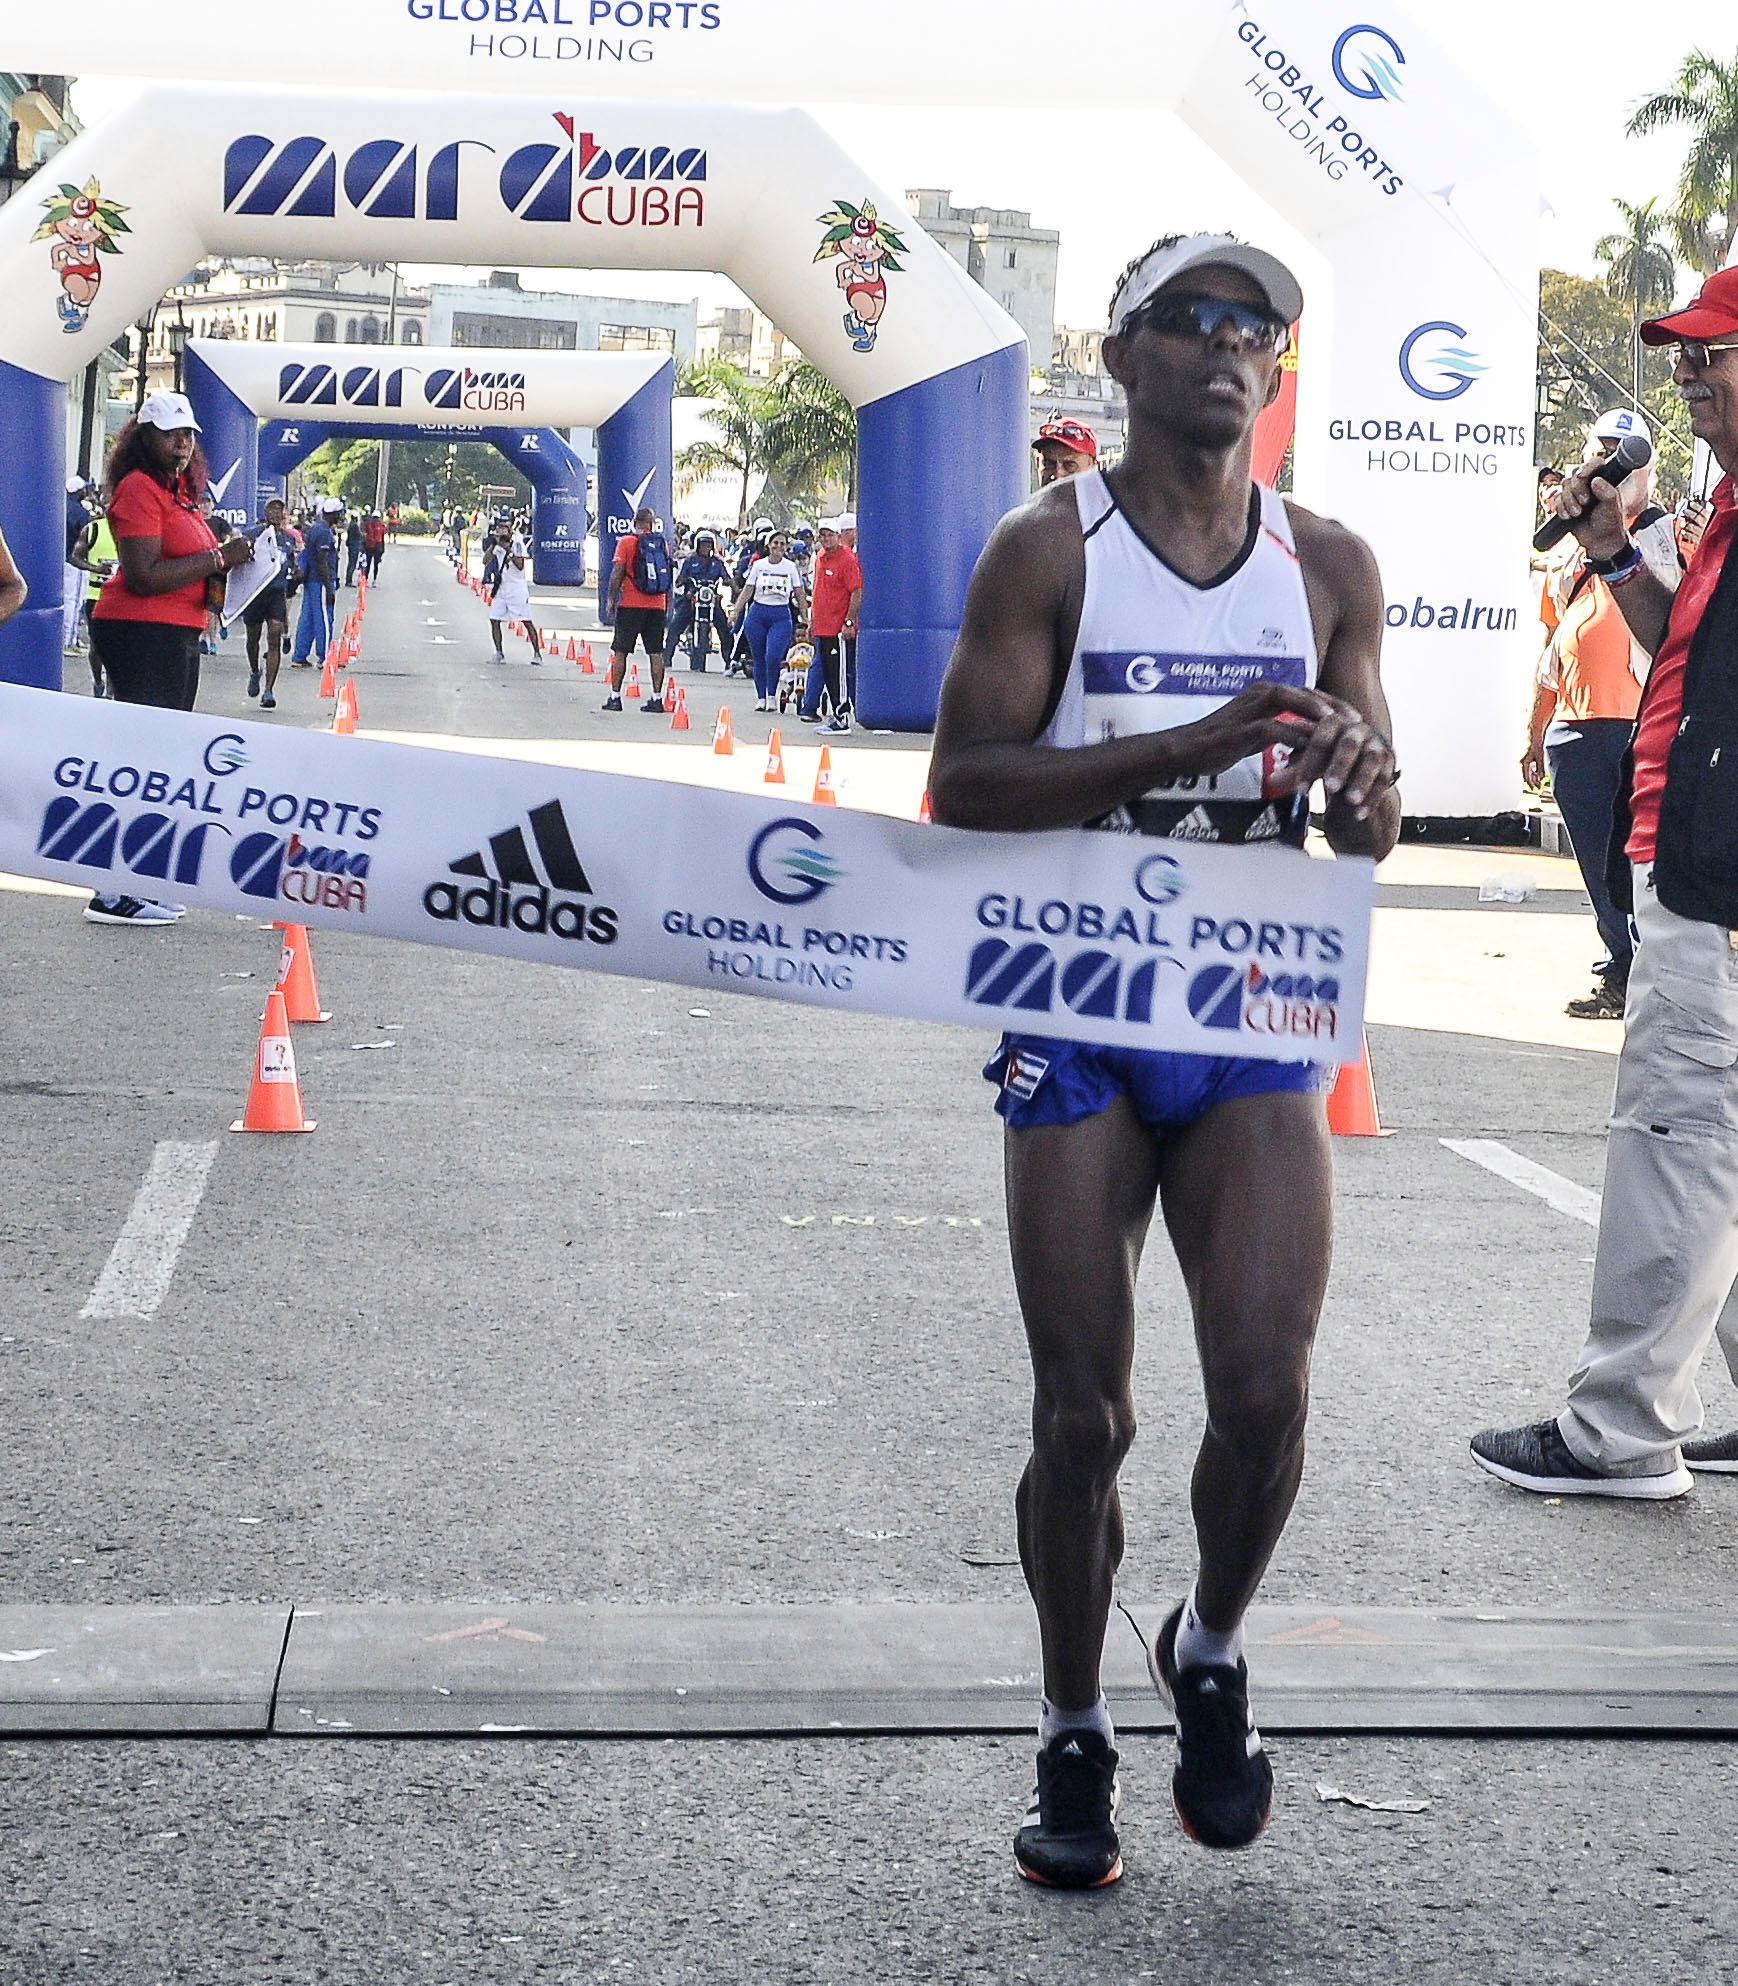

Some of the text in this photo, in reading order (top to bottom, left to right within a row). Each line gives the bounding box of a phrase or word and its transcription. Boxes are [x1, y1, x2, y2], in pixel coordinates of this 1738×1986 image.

[407, 0, 721, 29] GLOBAL PORTS
[470, 34, 654, 62] HOLDING
[1238, 21, 1403, 195] GLOBAL PORTS
[1245, 72, 1348, 181] HOLDING
[577, 185, 704, 227] CUBA
[464, 390, 525, 411] CUBA
[1329, 419, 1525, 446] GLOBAL PORTS
[1367, 450, 1498, 476] HOLDING
[53, 756, 384, 840] GLOBAL PORTS
[281, 869, 368, 914] CUBA
[423, 878, 619, 945] adidas
[662, 909, 909, 962] GLOBAL PORTS
[975, 892, 1345, 963] GLOBAL PORTS
[706, 949, 854, 992] HOLDING
[1245, 1000, 1337, 1040] CUBA
